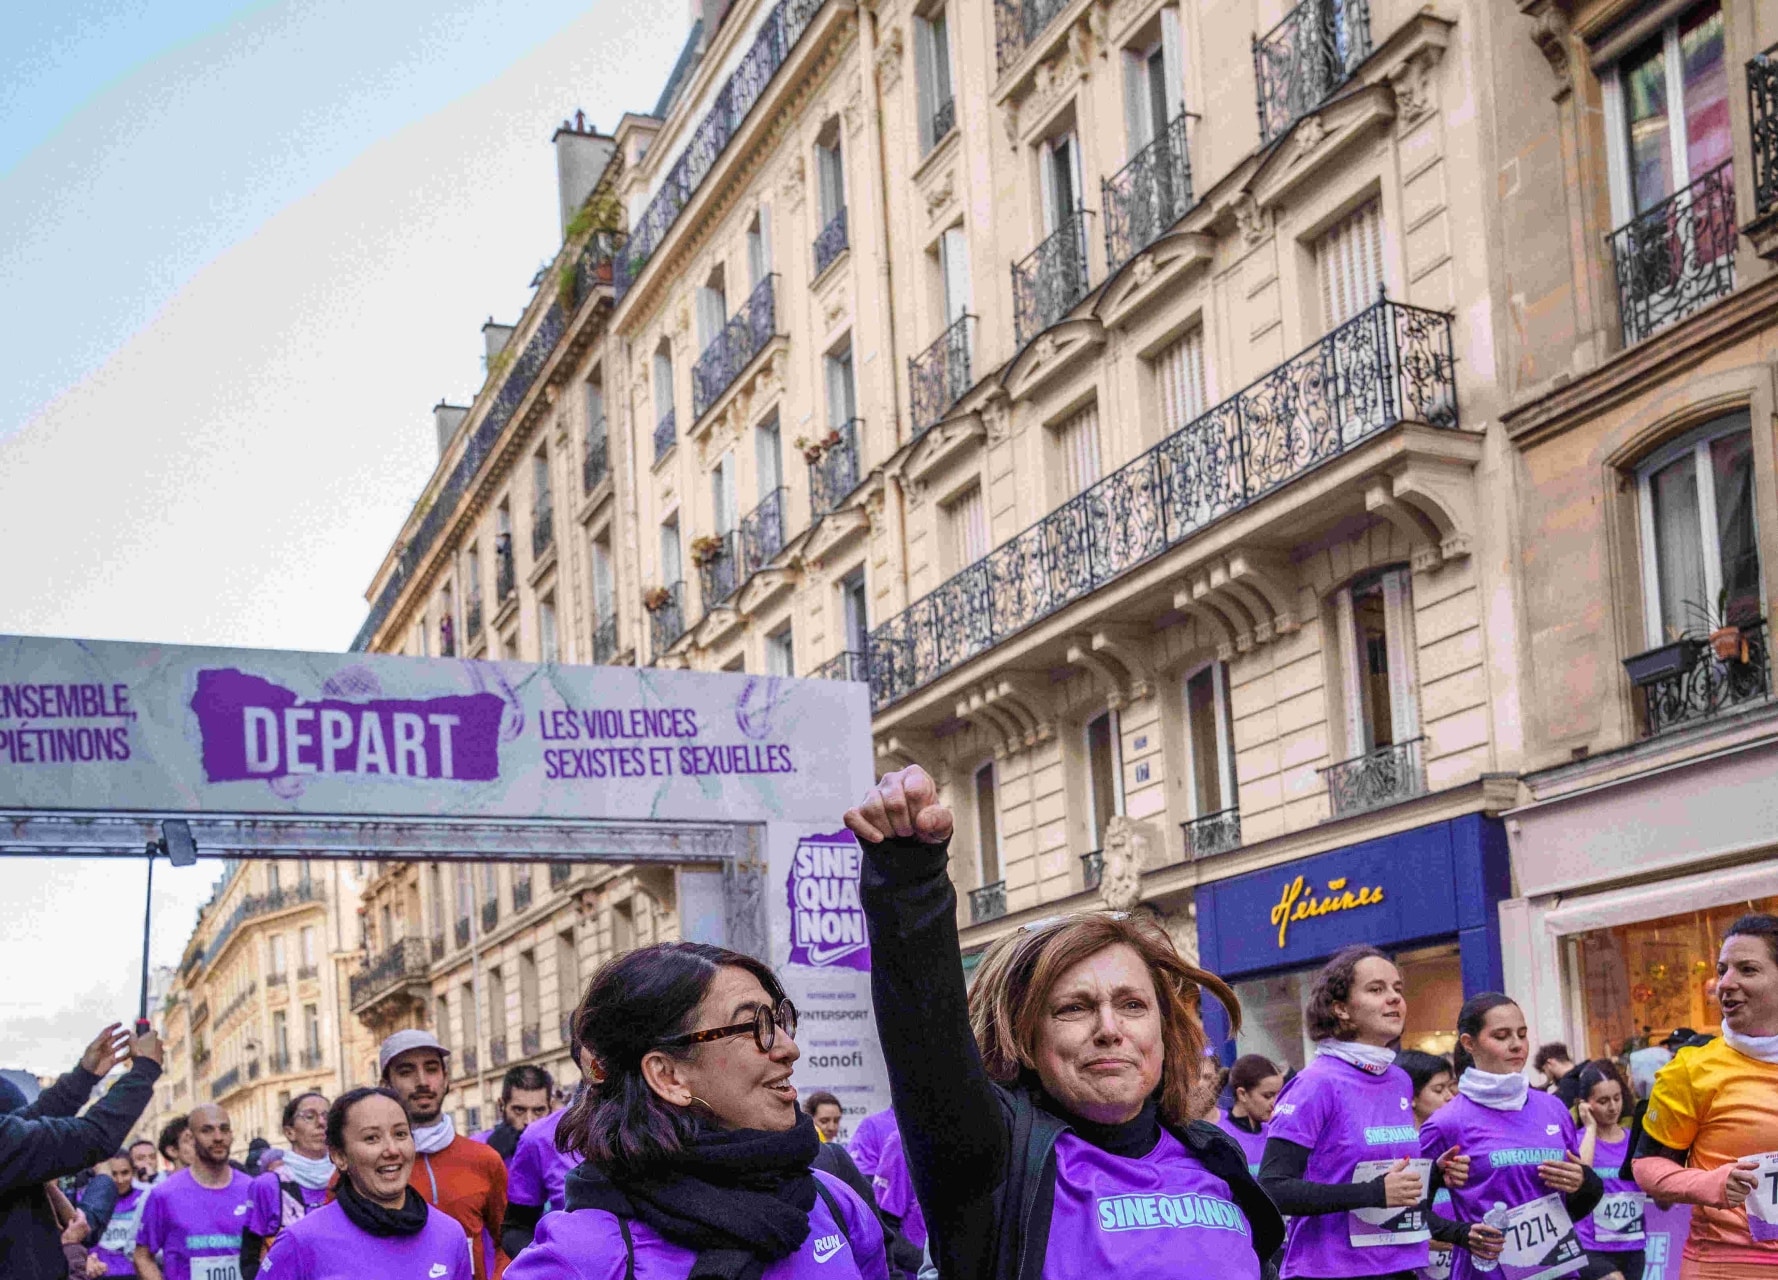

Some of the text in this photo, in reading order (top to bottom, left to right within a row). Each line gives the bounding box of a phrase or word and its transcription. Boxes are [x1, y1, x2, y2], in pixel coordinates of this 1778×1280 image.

[0, 684, 137, 722] NSEMBLE,
[540, 708, 698, 741] LES VIOLENCES
[545, 744, 798, 780] SEXISTES ET SEXUELLES.
[796, 846, 859, 878] SINE
[798, 879, 861, 912] QUA
[799, 911, 864, 944] NON
[808, 1050, 863, 1068] sanofi
[1098, 1196, 1246, 1233] SINEQUANON
[1603, 1201, 1636, 1220] 4226
[814, 1234, 840, 1253] RUN
[1507, 1212, 1559, 1252] 7274
